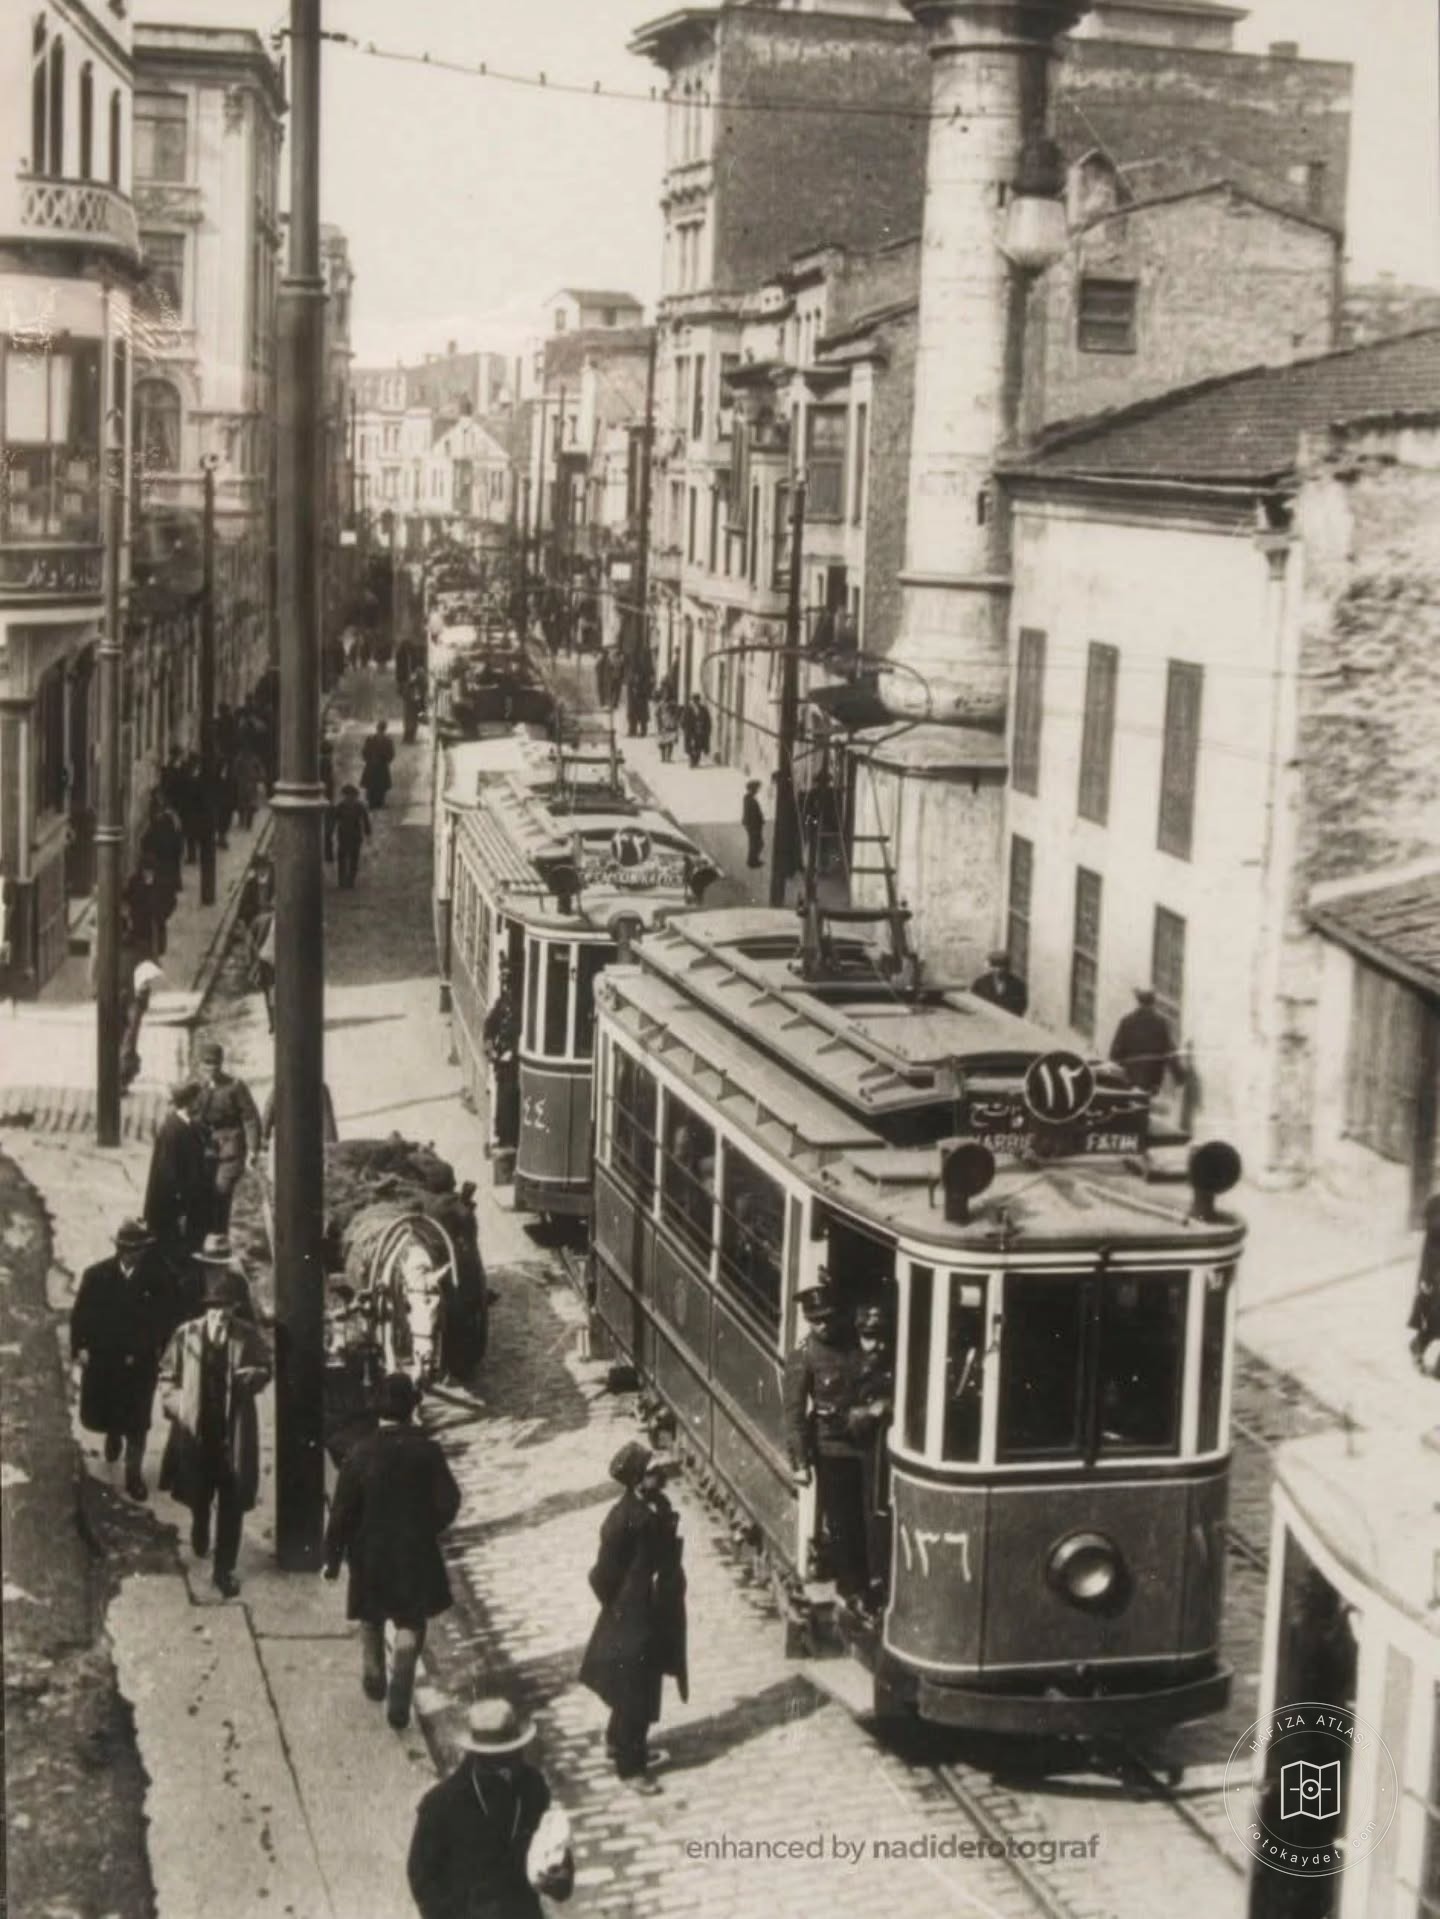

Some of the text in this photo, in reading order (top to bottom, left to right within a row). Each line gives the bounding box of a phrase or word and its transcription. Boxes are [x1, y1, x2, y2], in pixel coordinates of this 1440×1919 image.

[1039, 1063, 1084, 1108] ١٢
[1086, 1132, 1139, 1151] FATIH
[901, 1524, 971, 1582] ١٣٦
